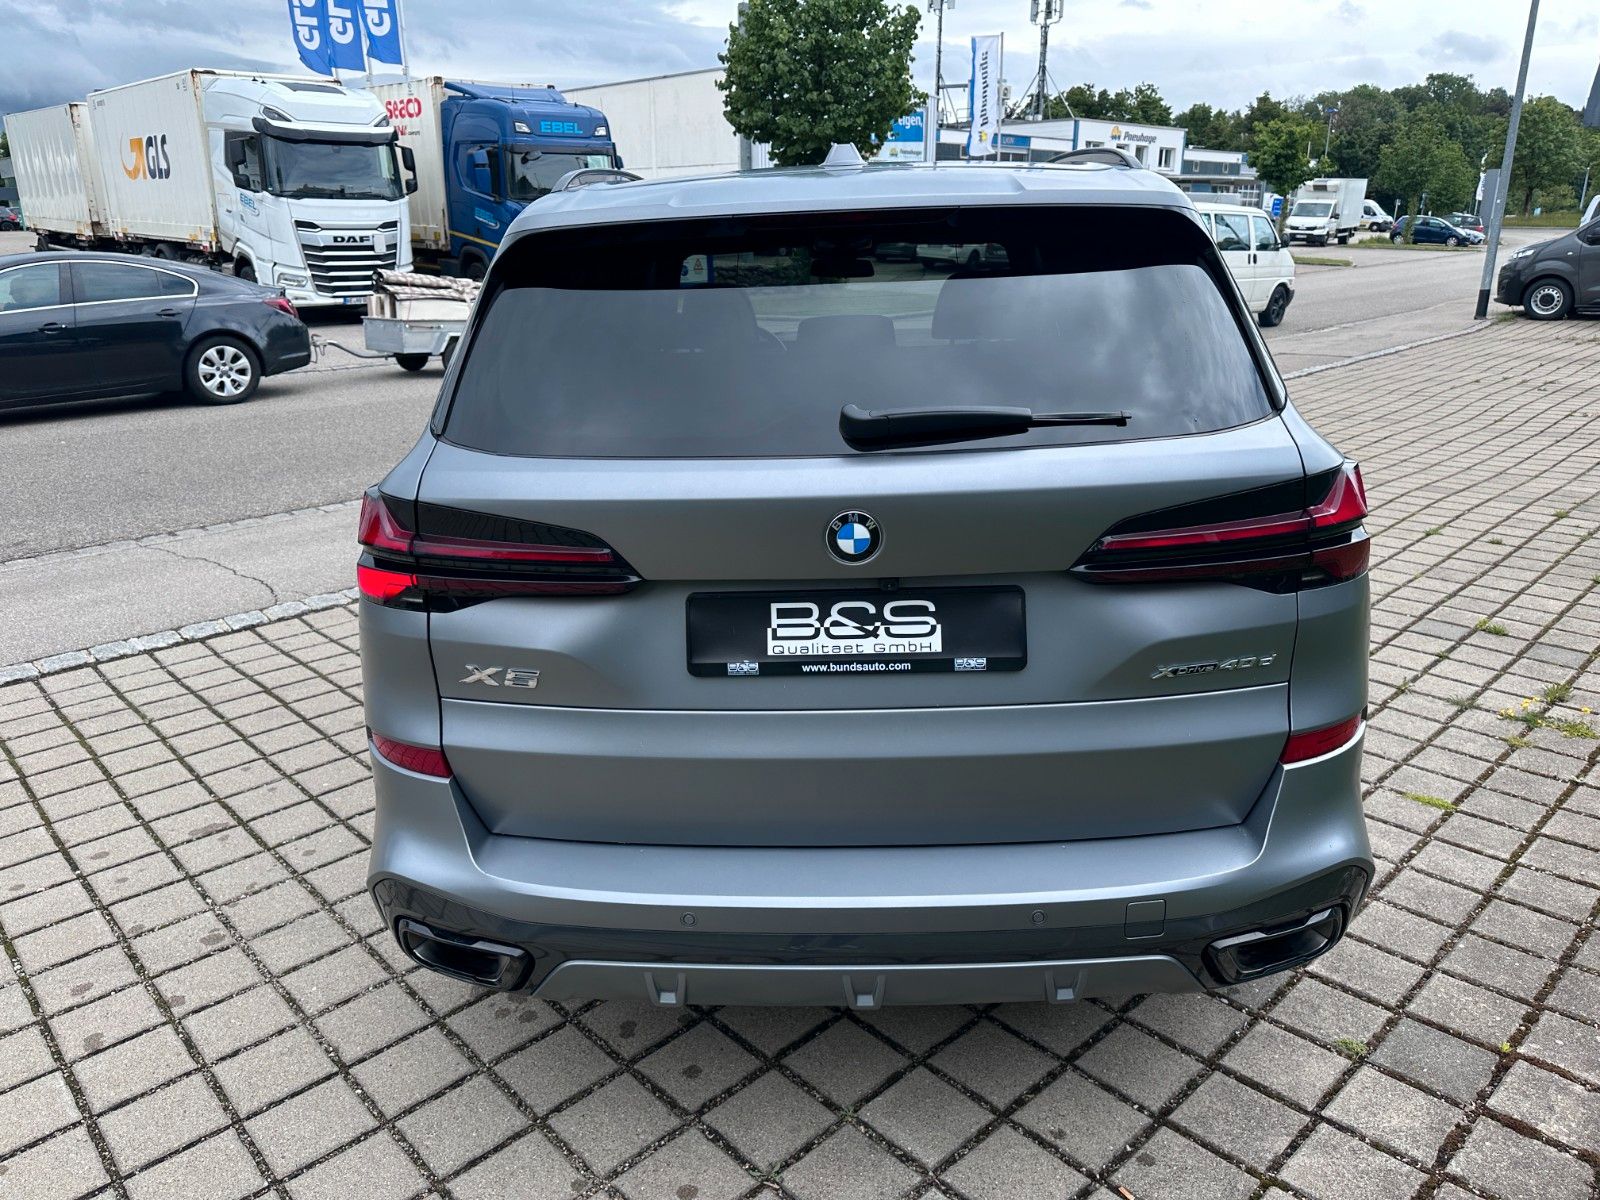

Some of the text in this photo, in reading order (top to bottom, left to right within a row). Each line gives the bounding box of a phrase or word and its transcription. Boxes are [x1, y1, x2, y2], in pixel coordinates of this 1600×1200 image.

[540, 120, 583, 134] EBEL
[145, 134, 171, 180] GLS
[332, 235, 371, 244] DAF
[831, 513, 876, 532] BMW
[770, 599, 937, 641] B&S
[772, 642, 864, 655] Qualitaet
[801, 662, 911, 673] www.bundsauto.com
[458, 663, 540, 689] X5
